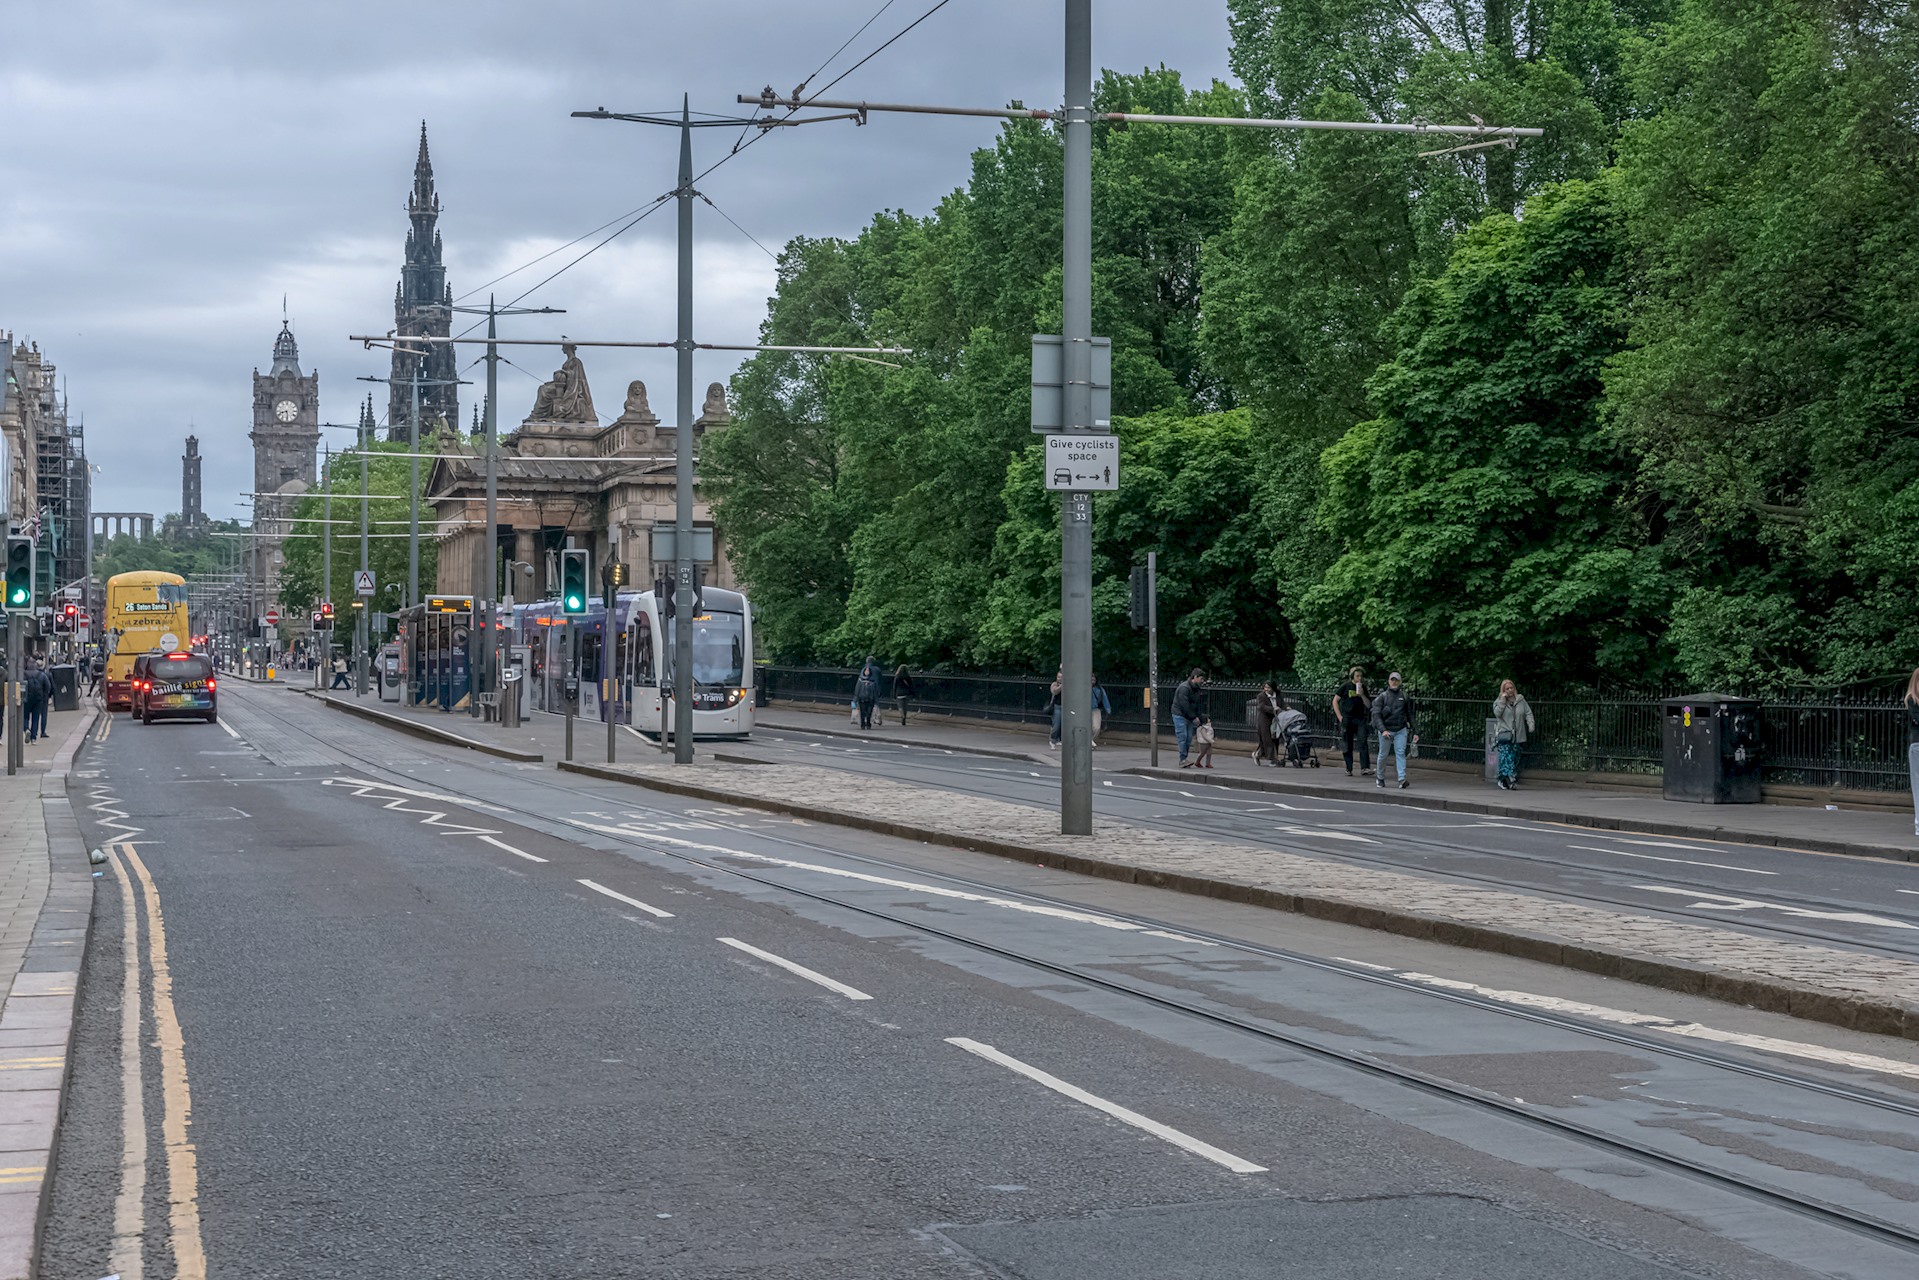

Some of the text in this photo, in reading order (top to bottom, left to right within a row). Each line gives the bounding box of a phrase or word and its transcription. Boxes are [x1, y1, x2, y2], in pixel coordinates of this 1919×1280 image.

[1050, 439, 1115, 451] Give cyclists
[1067, 453, 1097, 462] space
[1073, 493, 1089, 501] CTY
[1077, 503, 1086, 511] 12
[1076, 513, 1087, 521] 33
[125, 602, 135, 612] 26
[151, 603, 168, 611] Sands
[133, 617, 161, 626] zebra
[184, 678, 207, 689] signs
[702, 693, 725, 702] Trams
